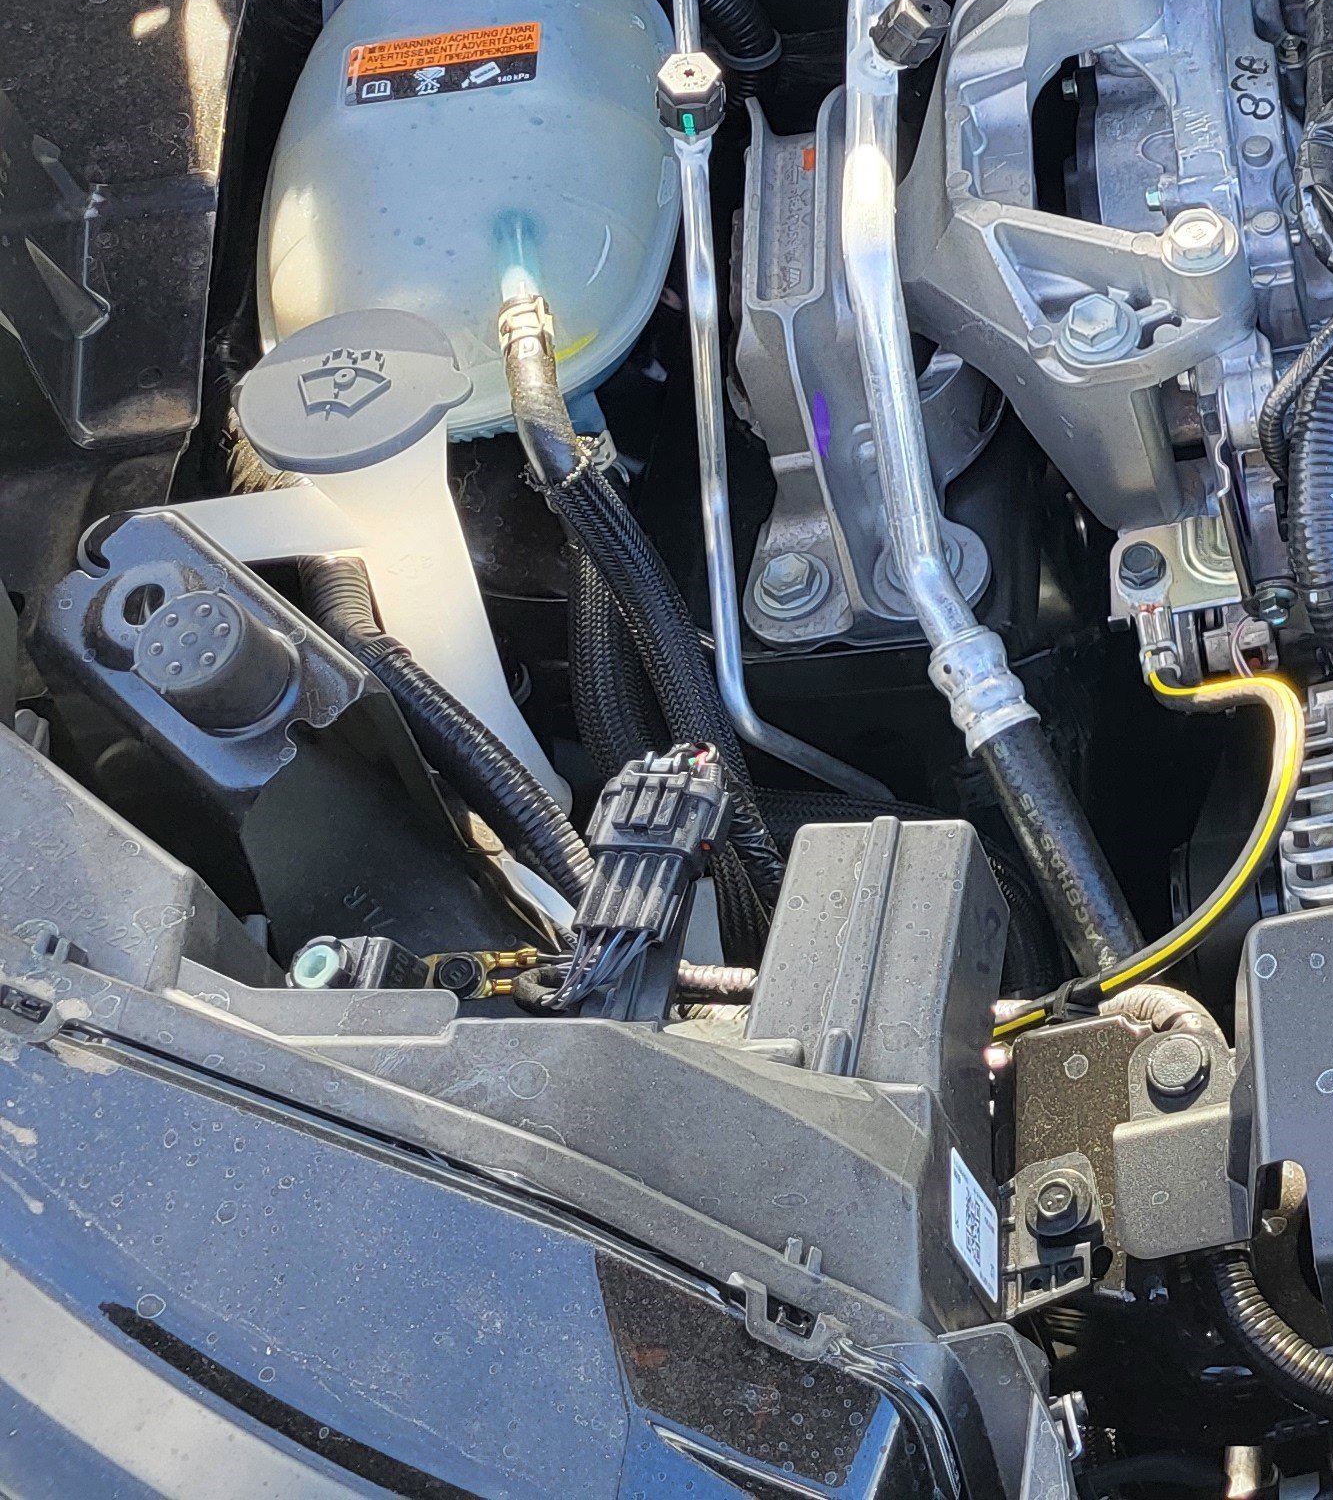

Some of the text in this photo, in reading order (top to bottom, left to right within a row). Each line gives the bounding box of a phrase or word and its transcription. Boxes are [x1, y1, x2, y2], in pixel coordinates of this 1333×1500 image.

[367, 43, 455, 63] AVERTISSEMENT
[462, 33, 535, 50] ADVERTÊNCIA
[393, 38, 442, 51] WARNING
[449, 29, 499, 43] ACHTUNG
[505, 24, 535, 35] UYARI
[497, 73, 529, 83] 140 kPa
